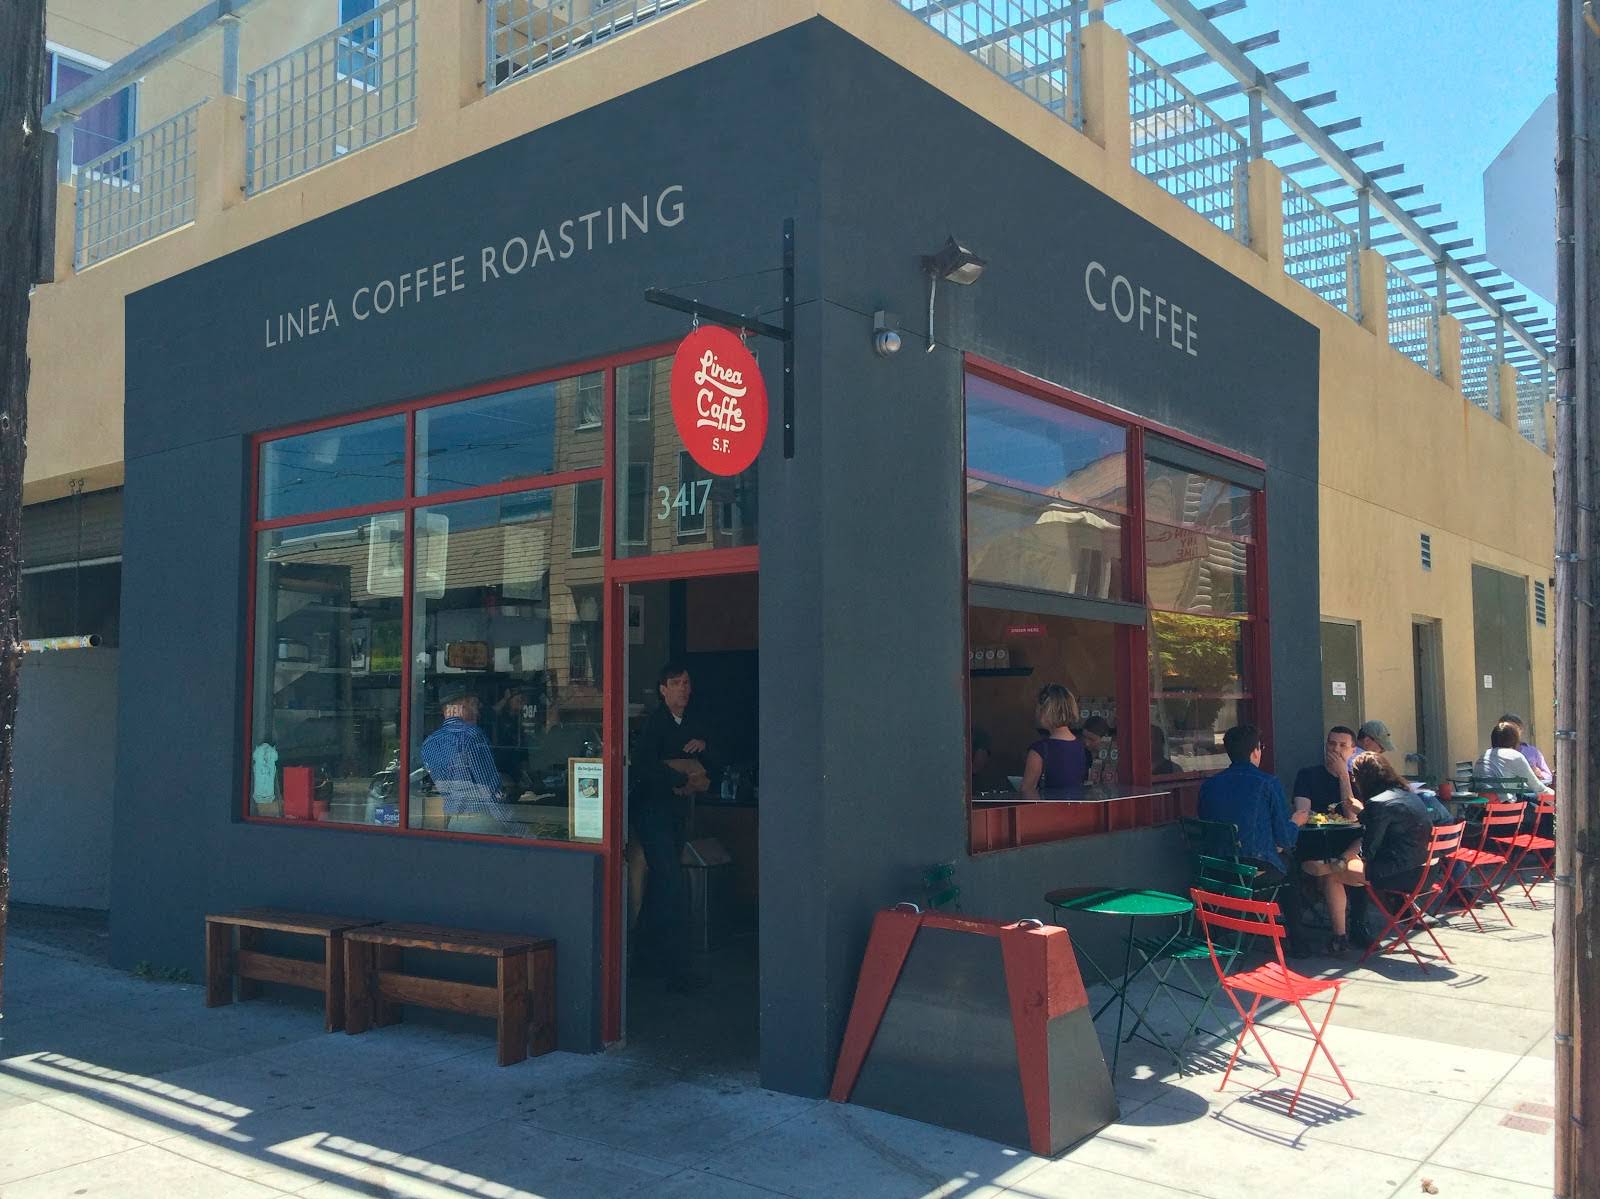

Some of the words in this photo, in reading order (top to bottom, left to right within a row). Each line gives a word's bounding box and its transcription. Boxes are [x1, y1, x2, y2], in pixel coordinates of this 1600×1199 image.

[265, 298, 340, 348] LINEA
[351, 254, 466, 321] COFFEE
[480, 184, 686, 283] ROASTING
[1084, 260, 1198, 357] COFFEE
[694, 349, 747, 398] Linea
[696, 388, 746, 433] Caffe
[712, 437, 731, 454] S.F.
[657, 478, 713, 521] 3417
